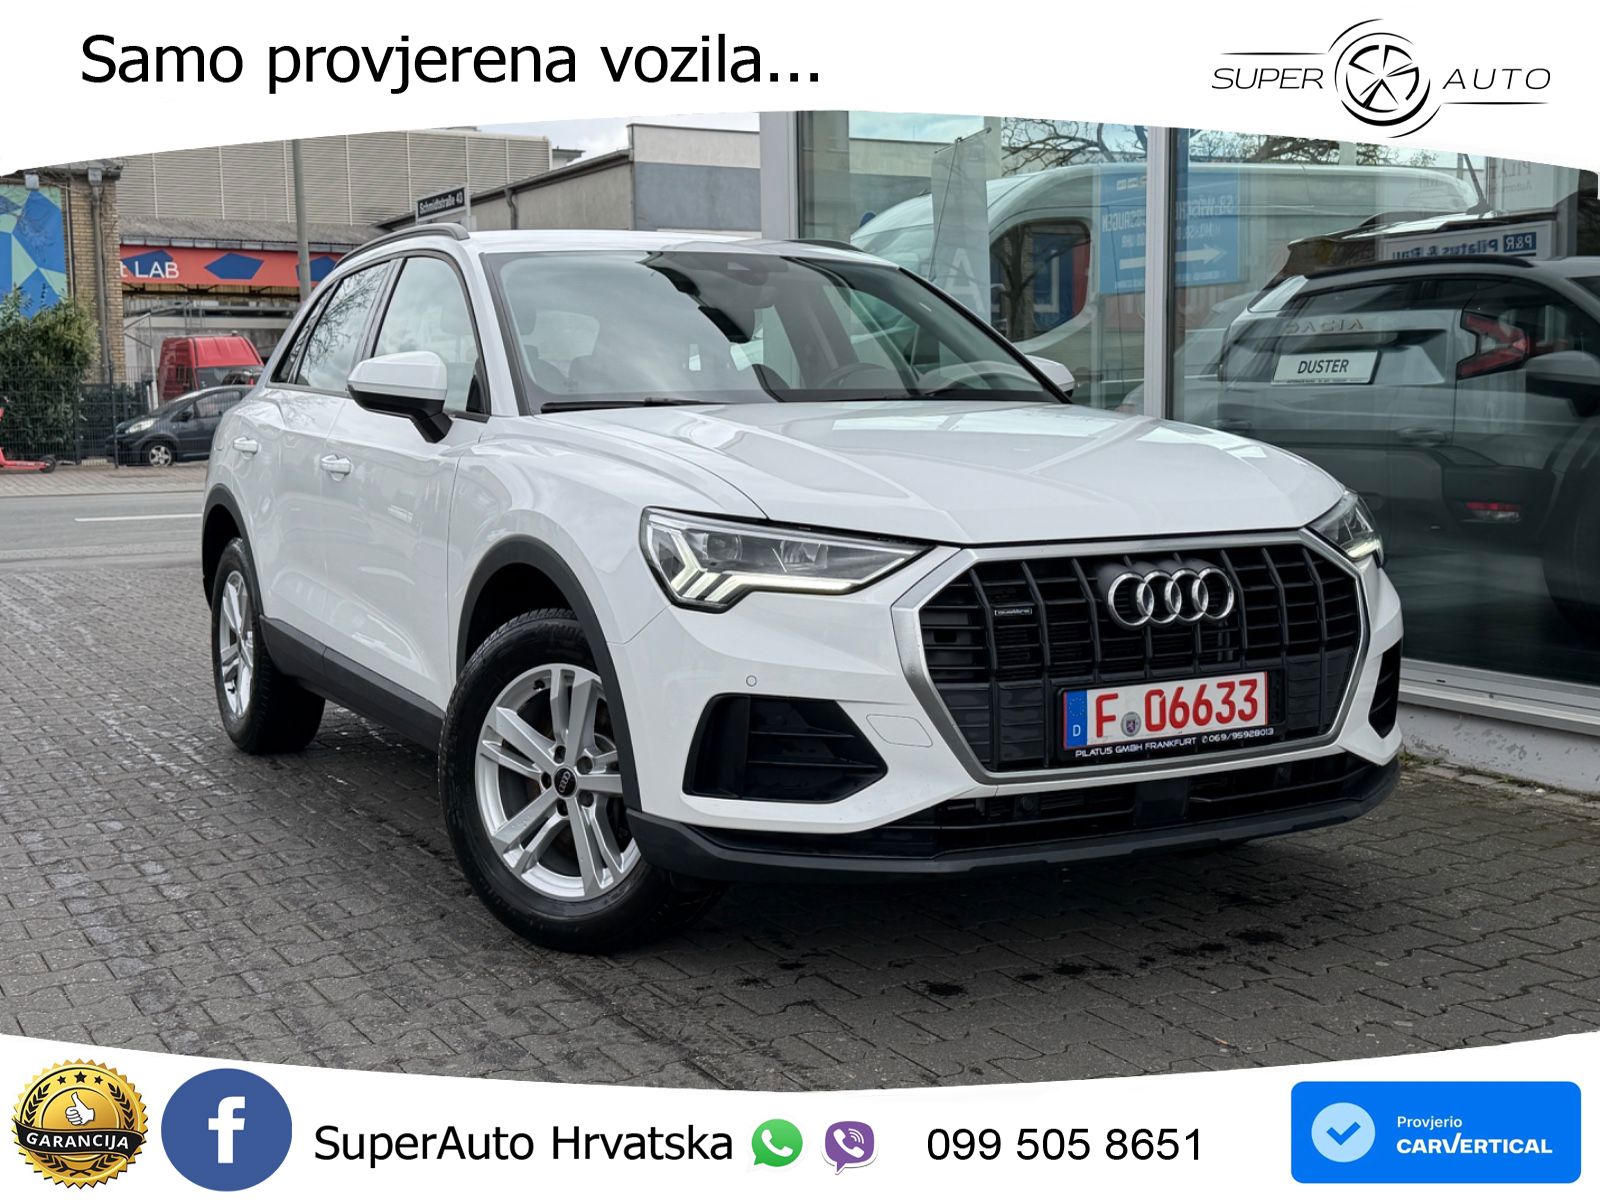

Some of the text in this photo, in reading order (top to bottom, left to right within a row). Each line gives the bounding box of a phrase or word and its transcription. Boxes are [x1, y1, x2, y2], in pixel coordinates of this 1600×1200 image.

[134, 260, 179, 279] LAB
[1297, 359, 1350, 374] DUSTER
[1072, 678, 1258, 738] D F 06633
[1075, 746, 1113, 758] PILATUS
[1115, 743, 1144, 754] GMBH
[1145, 736, 1197, 750] FRANKFURT
